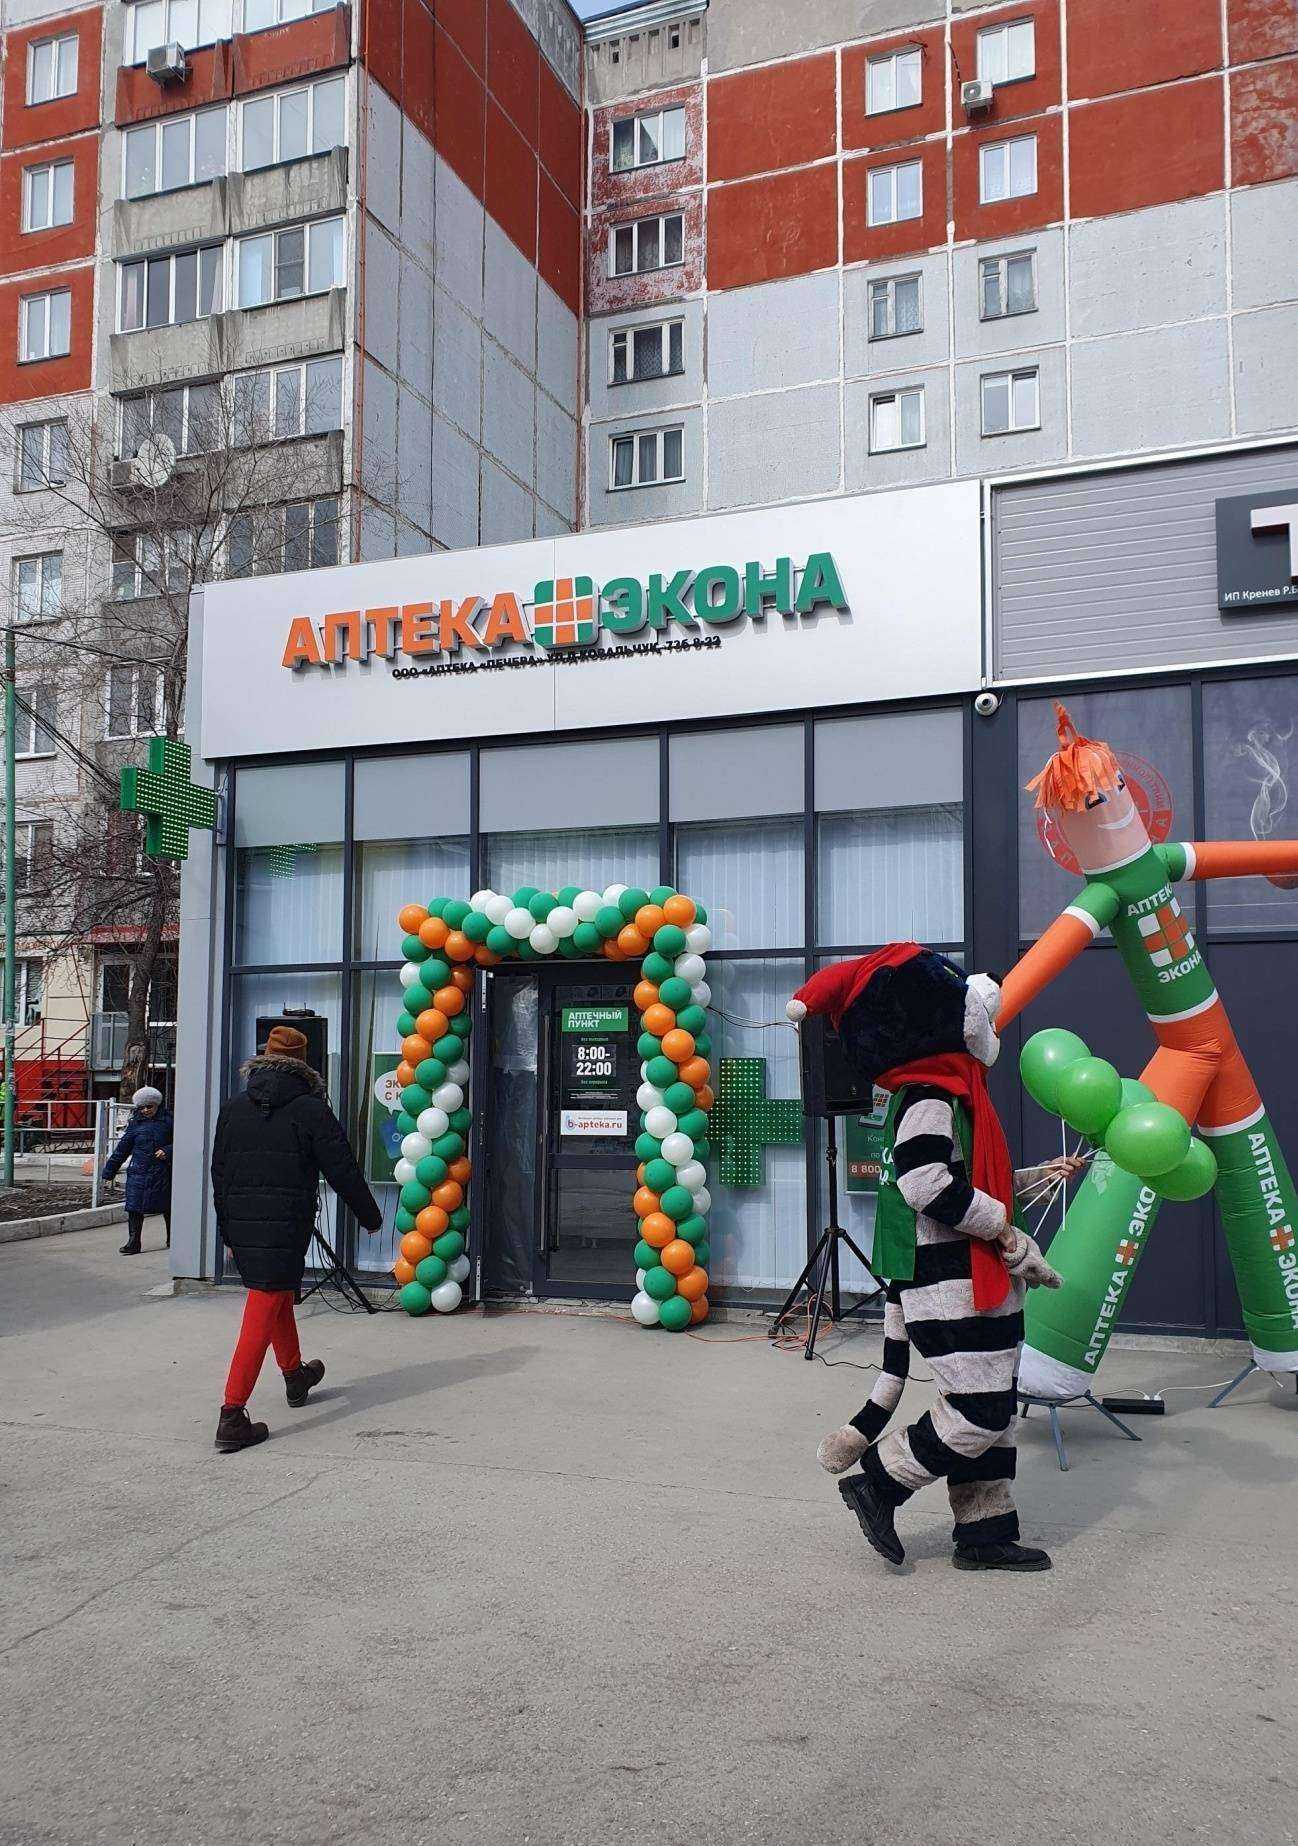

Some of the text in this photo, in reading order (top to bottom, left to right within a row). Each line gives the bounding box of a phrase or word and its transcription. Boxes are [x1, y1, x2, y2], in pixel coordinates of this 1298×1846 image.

[1225, 591, 1240, 602] ИП
[281, 552, 848, 669] АПТЕКА ЭКОНА
[1127, 882, 1173, 917] АПТЕК
[1157, 949, 1202, 984] ЭКОН
[568, 1010, 622, 1020] АПТЕЧНЫЙ
[568, 1020, 599, 1028] ПУНКТ
[577, 1046, 611, 1060] 8:00-
[575, 1061, 612, 1076] 22:00
[568, 1120, 622, 1130] b-apteka.ru
[1083, 1185, 1156, 1366] АПТЕКА ЭКО
